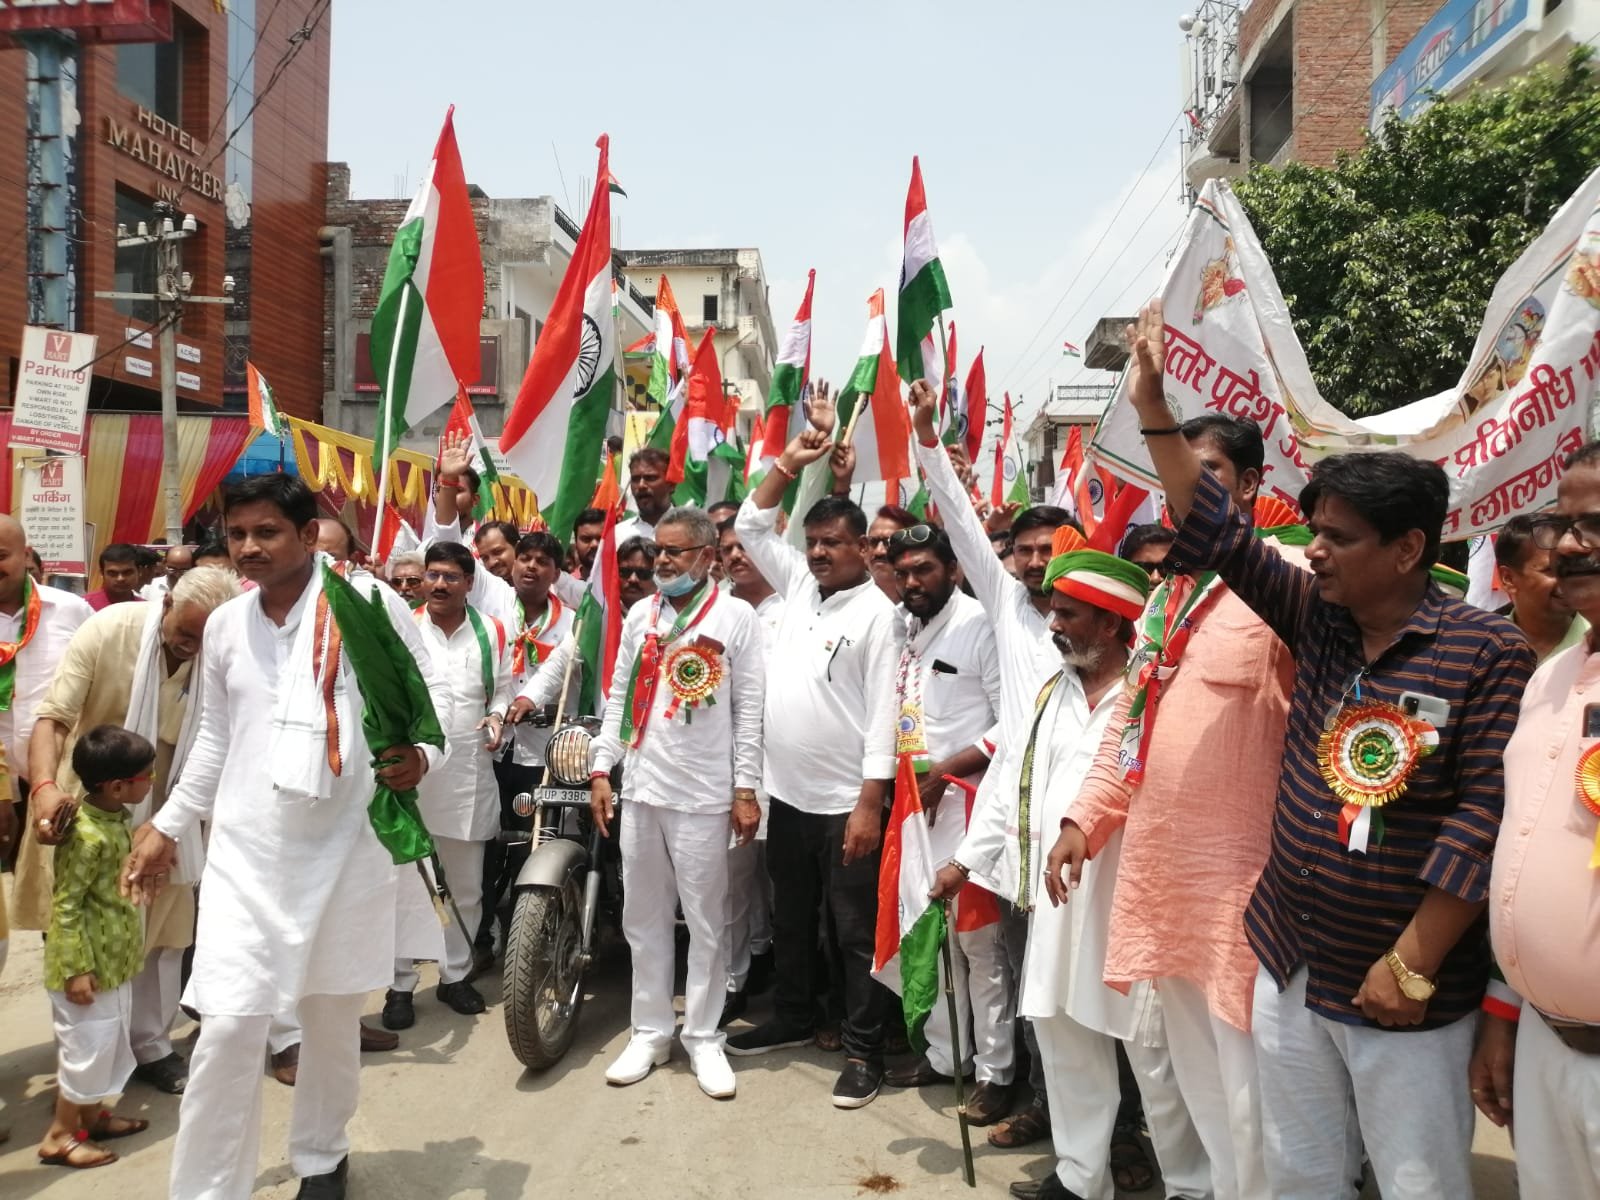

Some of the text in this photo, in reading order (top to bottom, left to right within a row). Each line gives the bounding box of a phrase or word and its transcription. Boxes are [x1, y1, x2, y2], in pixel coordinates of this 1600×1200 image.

[1413, 28, 1453, 84] VECTUS
[138, 104, 201, 157] HOTEL
[107, 115, 223, 201] MAHAVEER
[52, 335, 67, 352] V
[24, 360, 87, 385] Parking
[25, 379, 54, 388] PARKING
[63, 384, 80, 392] YOUR
[21, 402, 63, 413] RESPONSIBLE
[1205, 368, 1286, 440] प्रदेश
[53, 422, 79, 432] VEHICLE
[544, 789, 587, 801] UP 33BC
